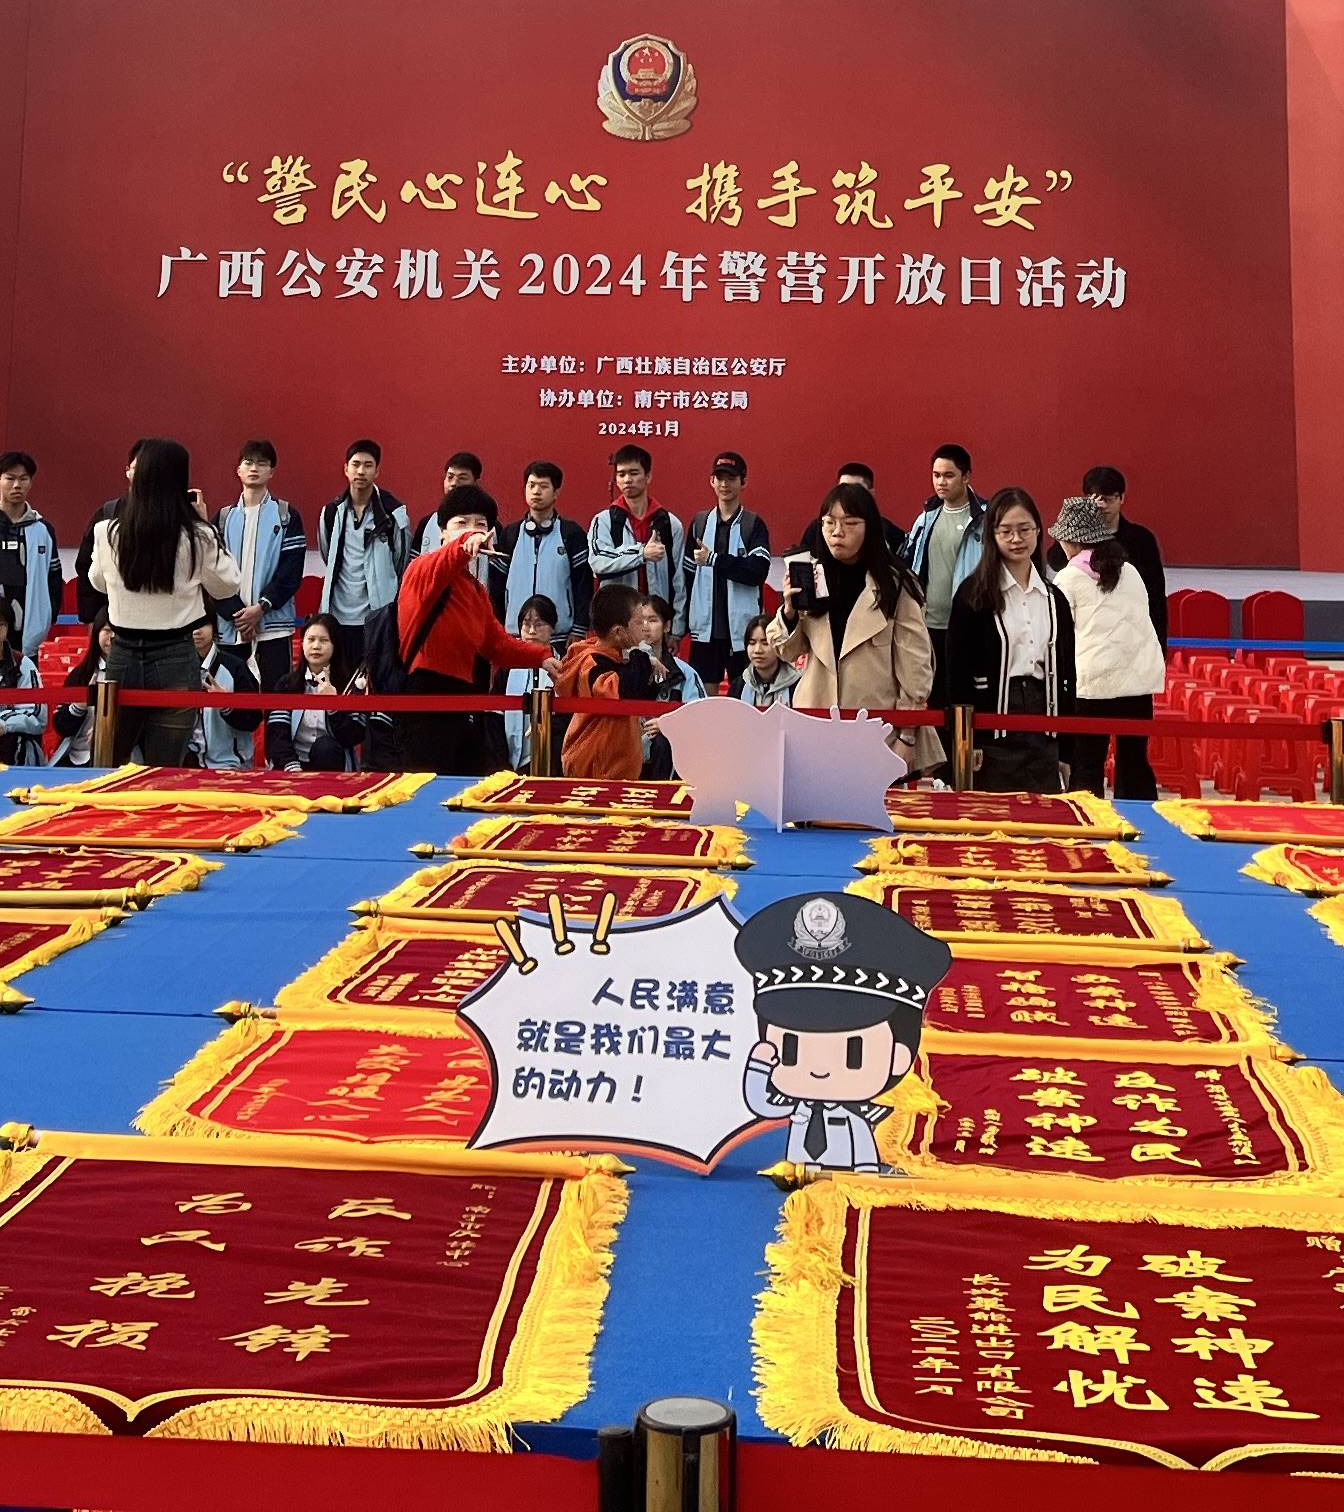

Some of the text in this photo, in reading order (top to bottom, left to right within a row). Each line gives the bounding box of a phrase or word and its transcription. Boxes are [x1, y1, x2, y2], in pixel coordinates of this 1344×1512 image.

[157, 248, 1127, 310] 广西公安机关2024年警营开放日活动
[501, 355, 787, 377] 主办单位：广西壮族自治区公安厅
[539, 389, 749, 410] 协办单位：南宁市公安局
[598, 420, 680, 438] 2024年1月
[592, 977, 735, 1016] 人民满意
[516, 1018, 732, 1061] 就是我们最大
[512, 1067, 643, 1104] 的动力！
[1010, 1067, 1105, 1161] 破案神速
[1112, 1071, 1201, 1167] 反诈为民
[1023, 1245, 1169, 1410] 为民解忧
[1138, 1250, 1320, 1419] 破案神速
